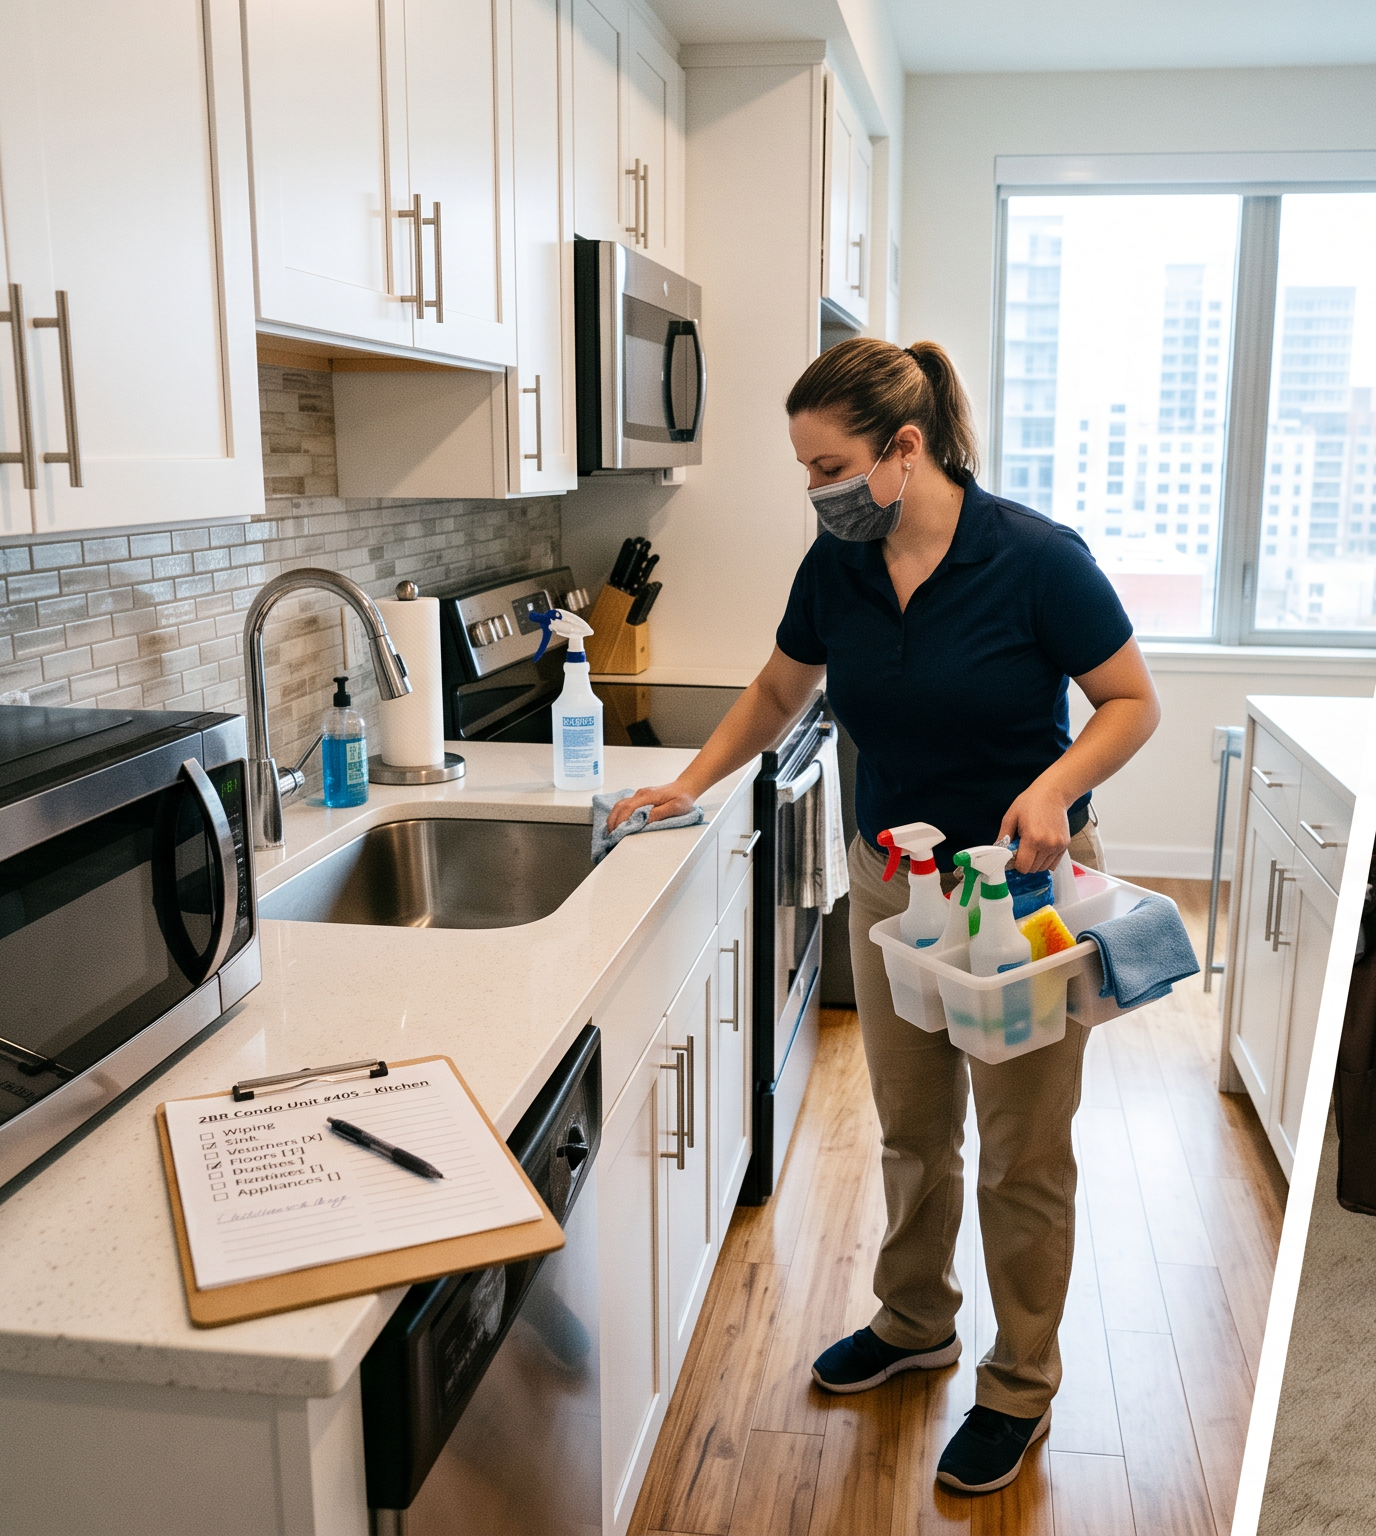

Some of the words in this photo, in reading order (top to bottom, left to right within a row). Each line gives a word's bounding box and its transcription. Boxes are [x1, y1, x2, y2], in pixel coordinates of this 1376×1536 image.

[199, 1113, 229, 1124] 2BR
[234, 1105, 283, 1118] Condo
[287, 1098, 320, 1109] Unit
[374, 1080, 429, 1093] Kitchen
[223, 1122, 276, 1137] Wiping
[230, 1152, 277, 1165] Floors
